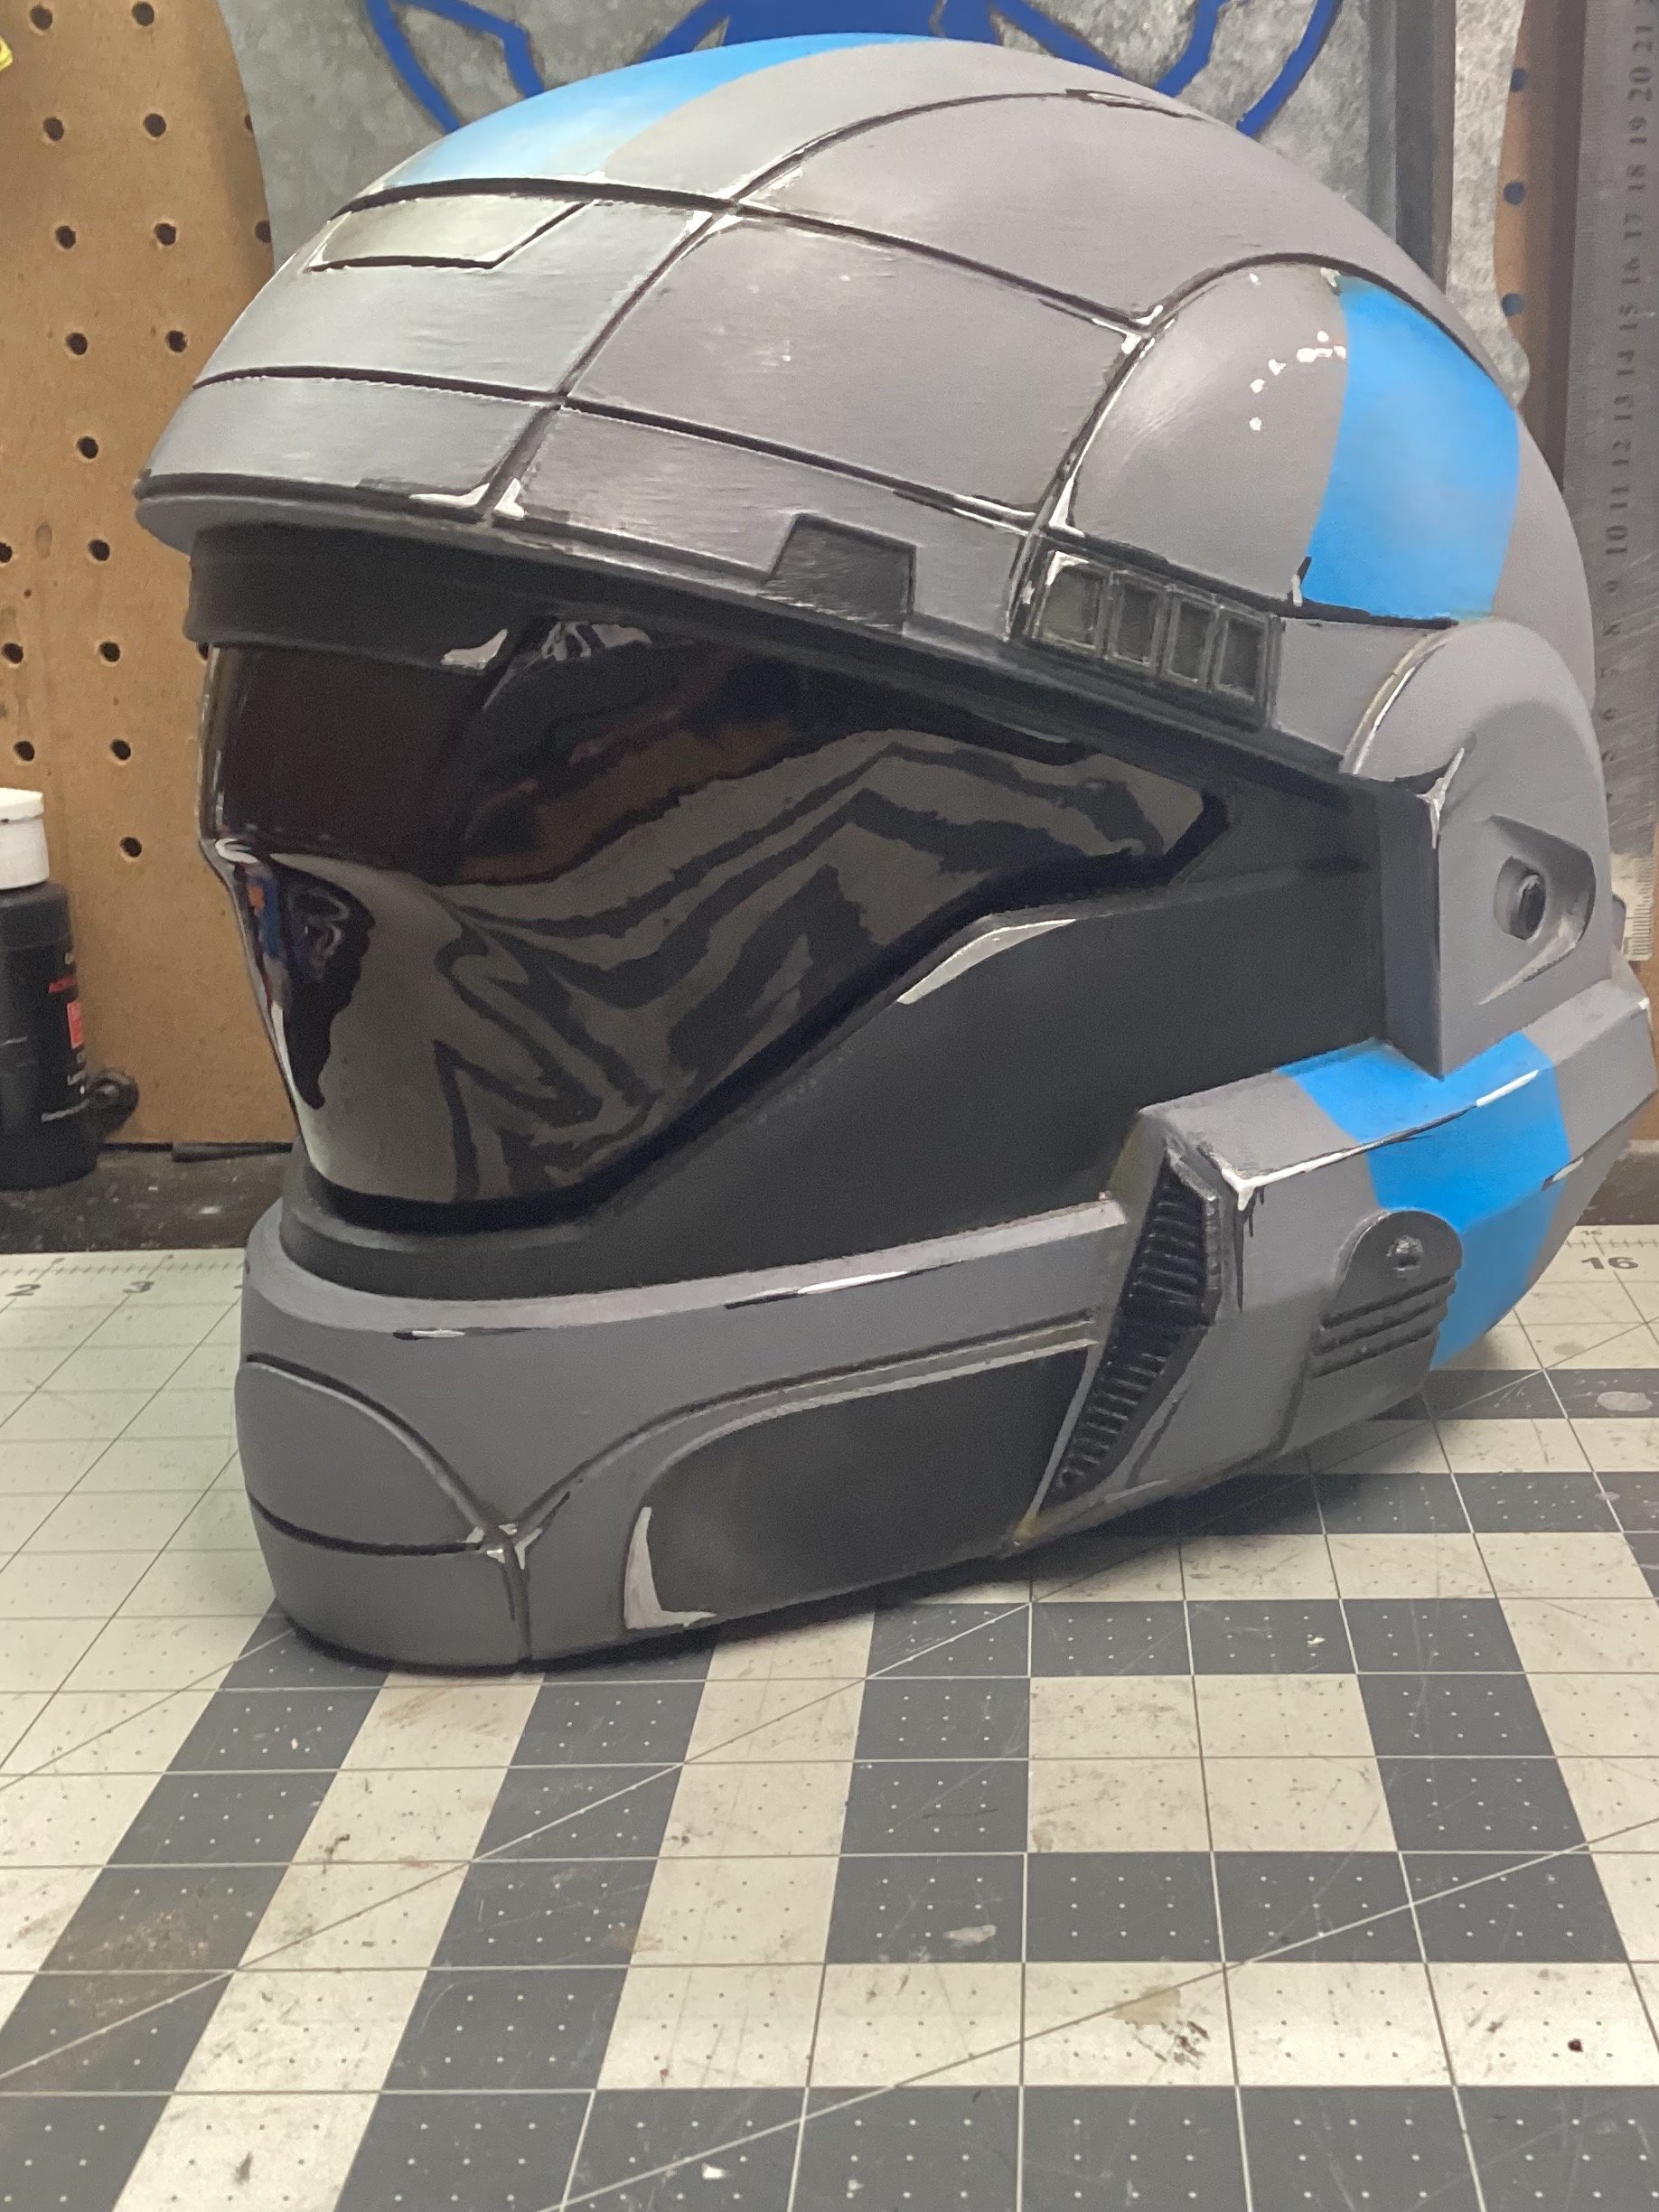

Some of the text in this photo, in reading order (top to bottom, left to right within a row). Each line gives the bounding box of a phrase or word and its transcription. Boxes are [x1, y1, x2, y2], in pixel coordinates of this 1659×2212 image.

[1632, 25, 1654, 52] 21
[1627, 66, 1654, 102] 20
[1628, 116, 1647, 144] 19
[1626, 164, 1646, 191] 18
[1609, 486, 1629, 510] 11
[1606, 525, 1627, 555] 10
[1580, 1256, 1639, 1270] 16
[5, 1283, 42, 1297] 2
[123, 1280, 155, 1294] 3
